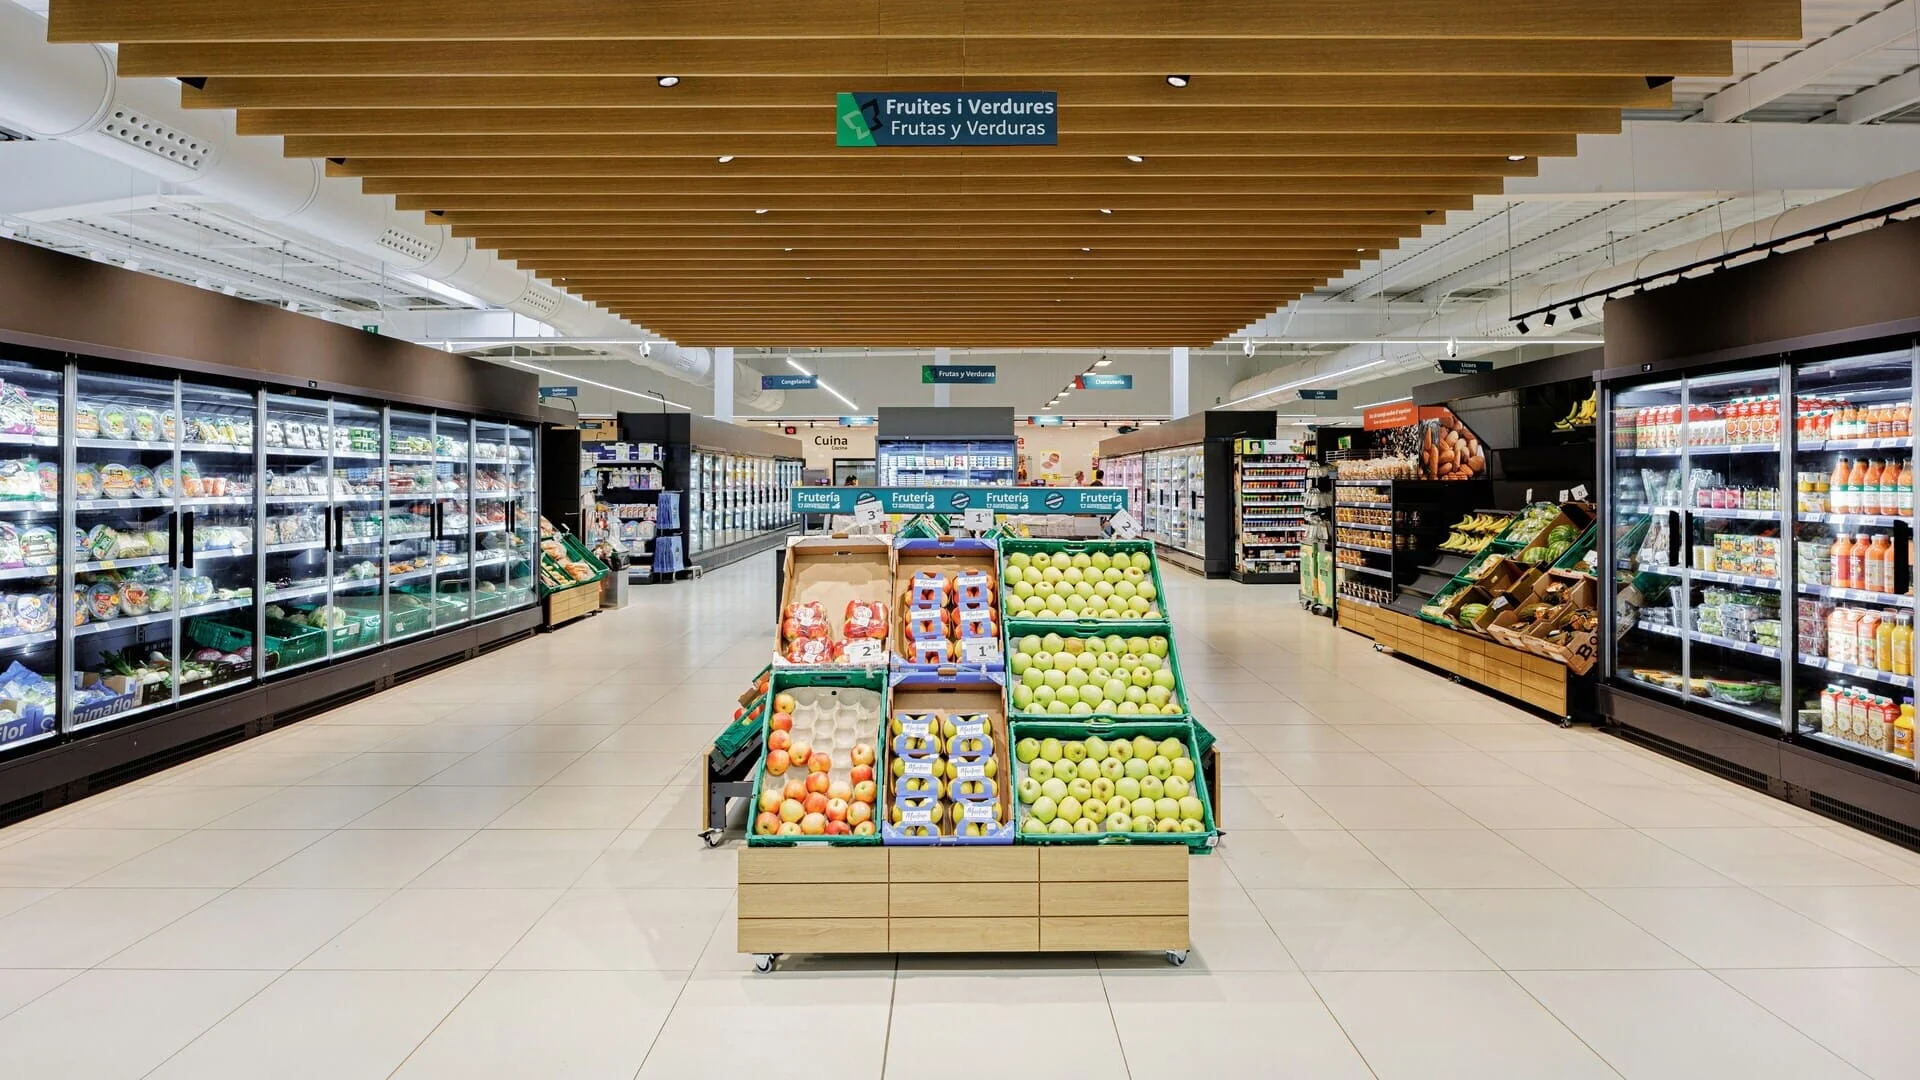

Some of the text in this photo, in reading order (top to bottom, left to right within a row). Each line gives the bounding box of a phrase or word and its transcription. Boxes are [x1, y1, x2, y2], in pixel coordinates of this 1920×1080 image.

[886, 98, 1055, 114] Fruites i Verdures
[891, 120, 1046, 139] Frutas y Verduras
[814, 435, 848, 446] Cuina
[798, 491, 840, 502] Frutería
[892, 491, 935, 502] Frutería
[986, 492, 1029, 502] Frutería
[1080, 492, 1122, 502] Frutería
